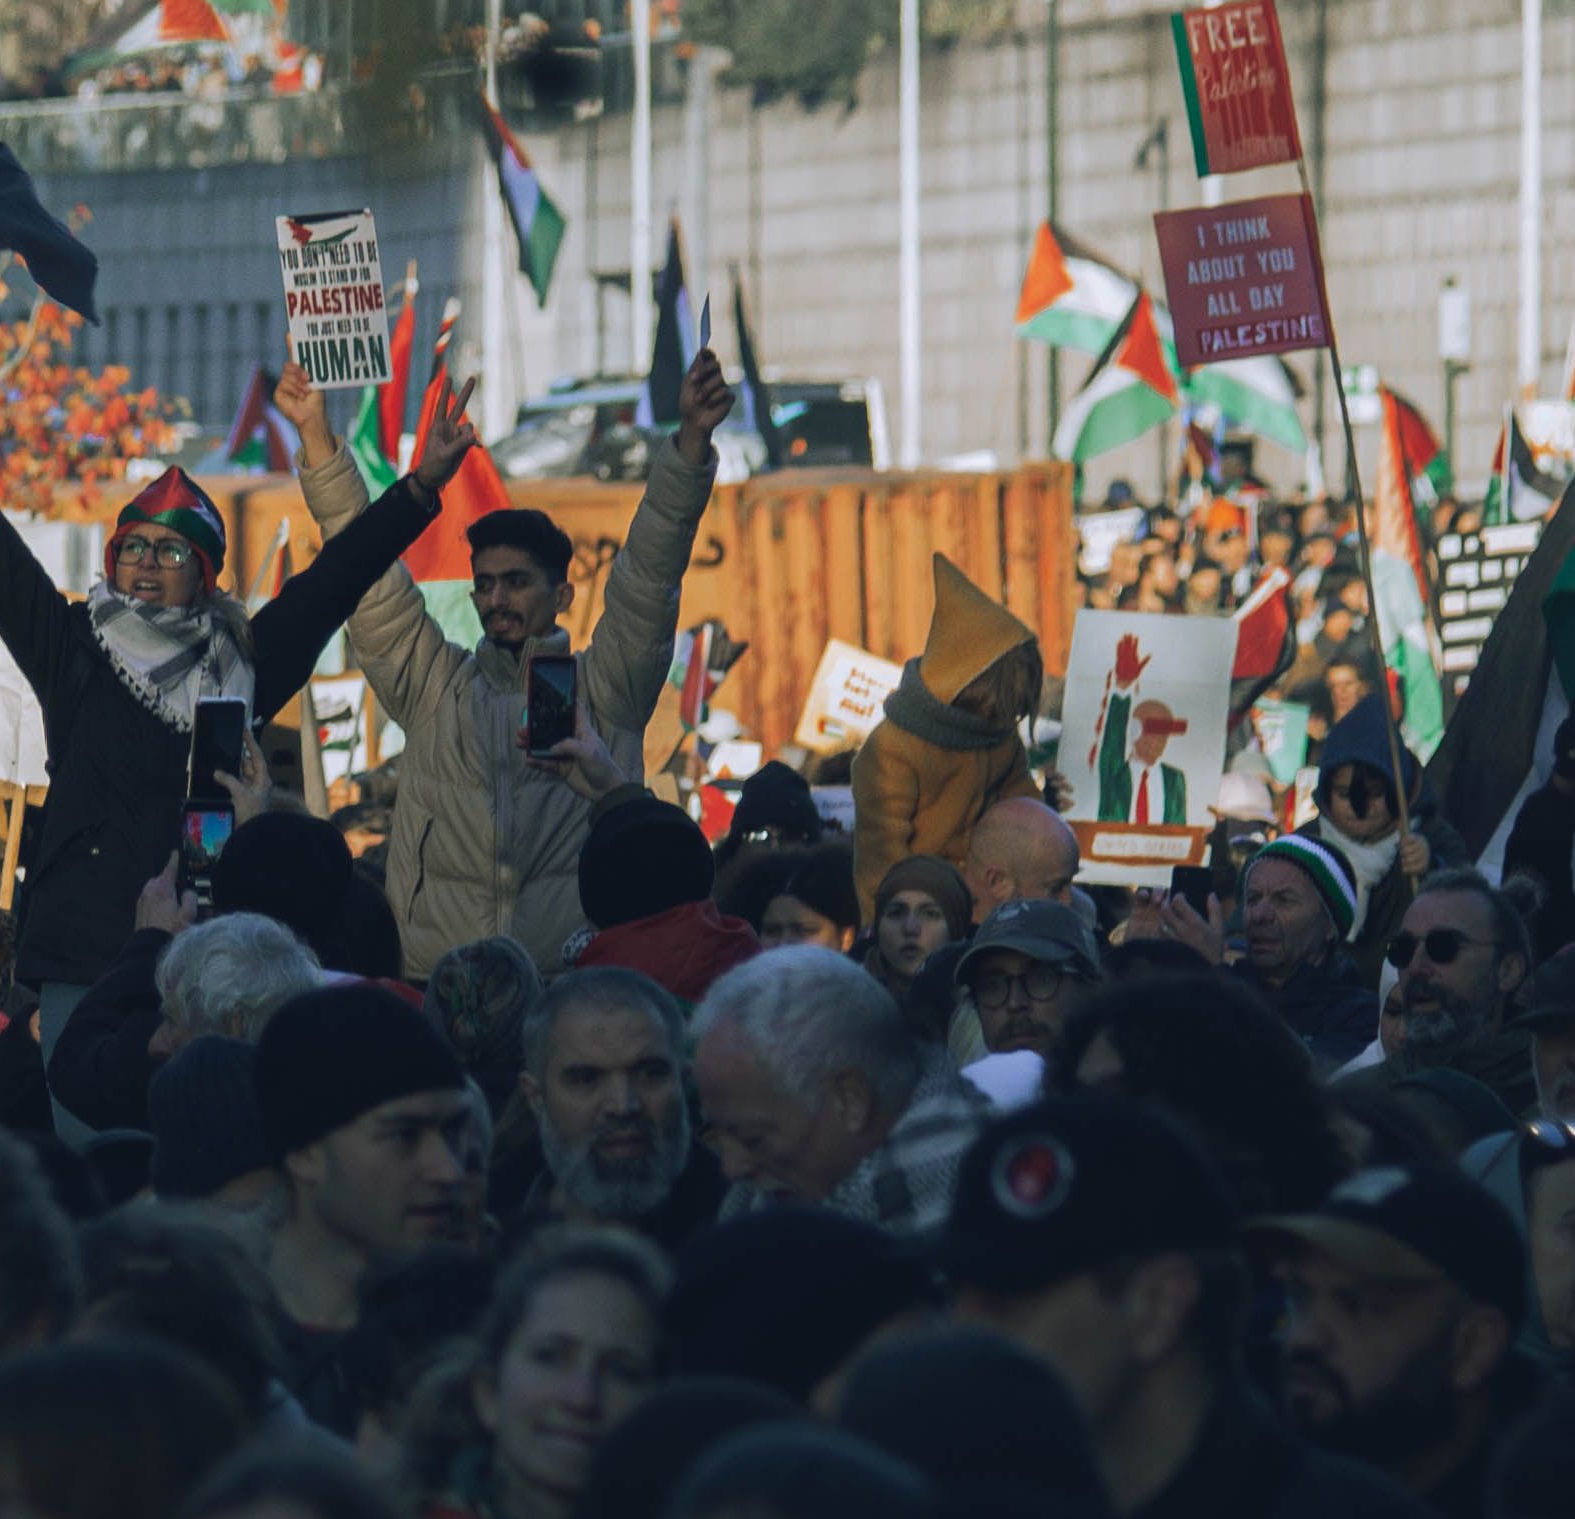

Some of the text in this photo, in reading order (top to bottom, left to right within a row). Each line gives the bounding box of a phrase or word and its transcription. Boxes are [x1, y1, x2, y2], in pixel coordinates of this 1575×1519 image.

[1187, 5, 1268, 54] FREE
[1197, 216, 1271, 249] I THINK
[281, 248, 299, 271] YOU
[329, 242, 351, 267] NEED
[354, 241, 365, 264] TO
[367, 239, 378, 263] BE
[1187, 247, 1296, 285] ABOUT YOU
[286, 283, 384, 320] PALESTINE
[1207, 283, 1285, 318] ALL DAY
[1200, 313, 1322, 354] PALESTINE
[297, 334, 388, 383] HUMAN
